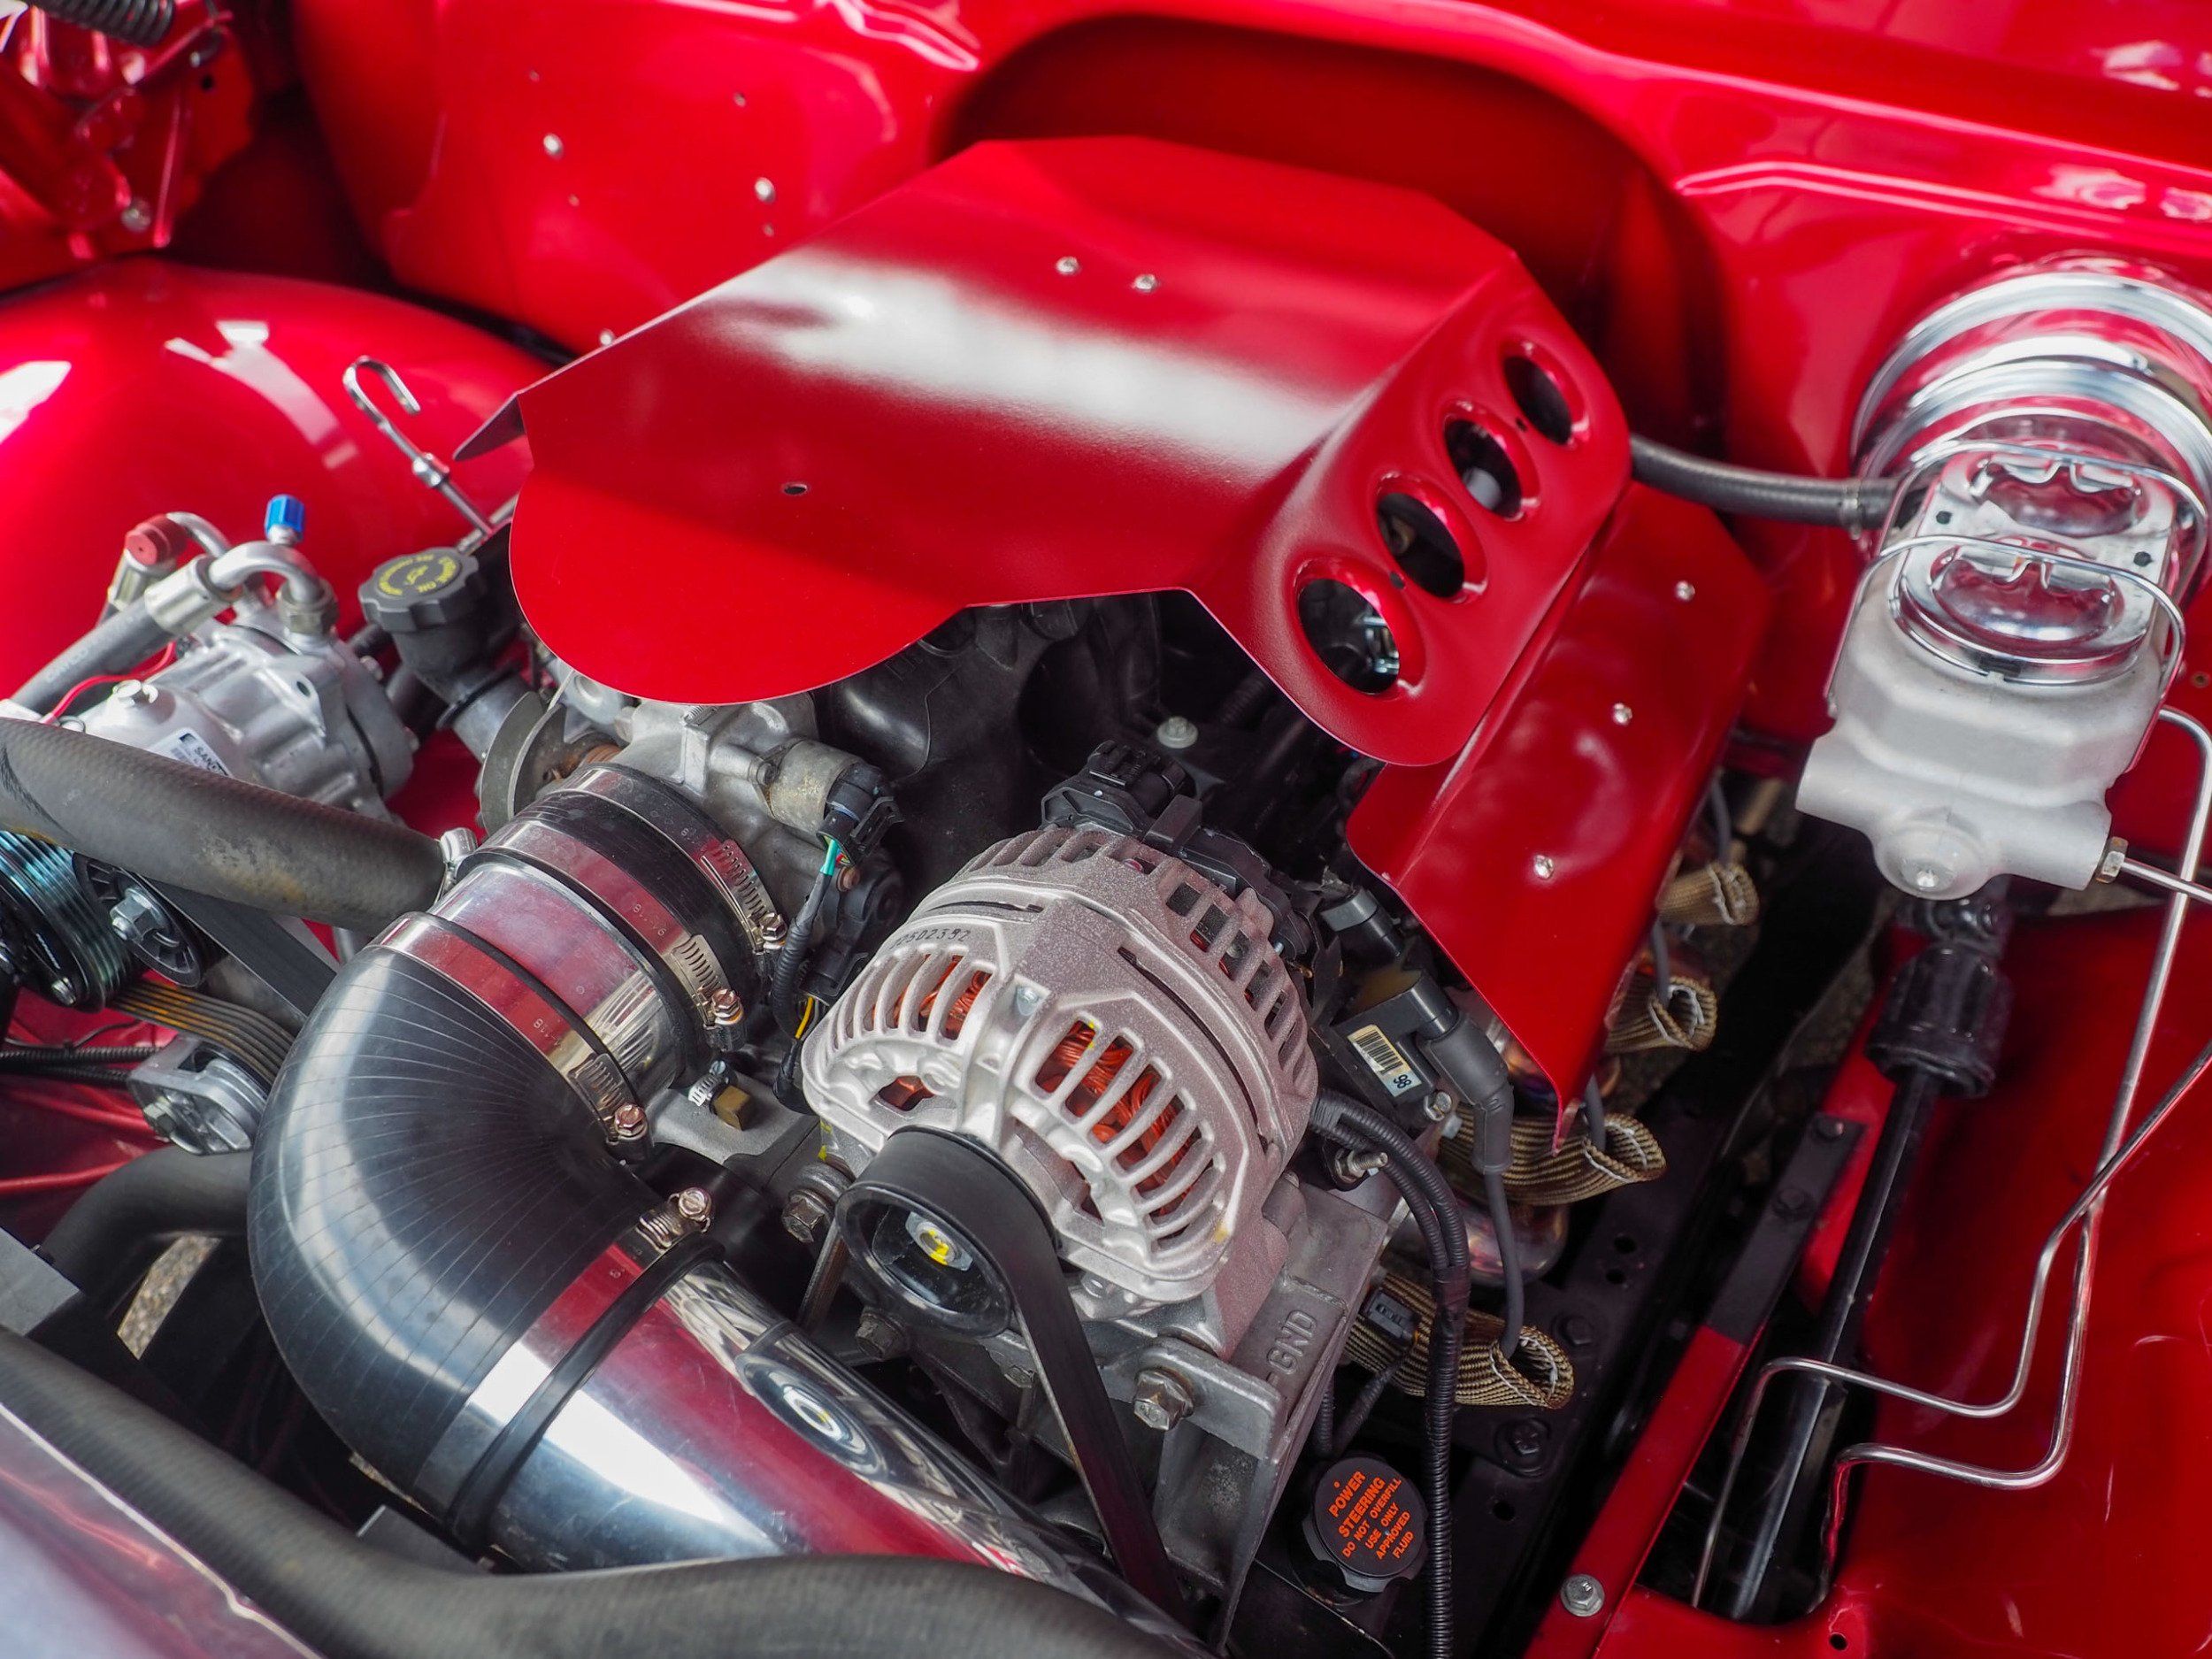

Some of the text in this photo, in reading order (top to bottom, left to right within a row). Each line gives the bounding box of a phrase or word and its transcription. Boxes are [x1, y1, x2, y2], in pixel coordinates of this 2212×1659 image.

[1328, 1471, 1366, 1517] POWER
[1338, 1477, 1386, 1538] STEERING
[1342, 1478, 1402, 1558] DO NOT OVERFILL
[1364, 1502, 1400, 1549] USE ONLY
[1376, 1511, 1411, 1560] APPROVED
[1392, 1531, 1414, 1559] FLUID
